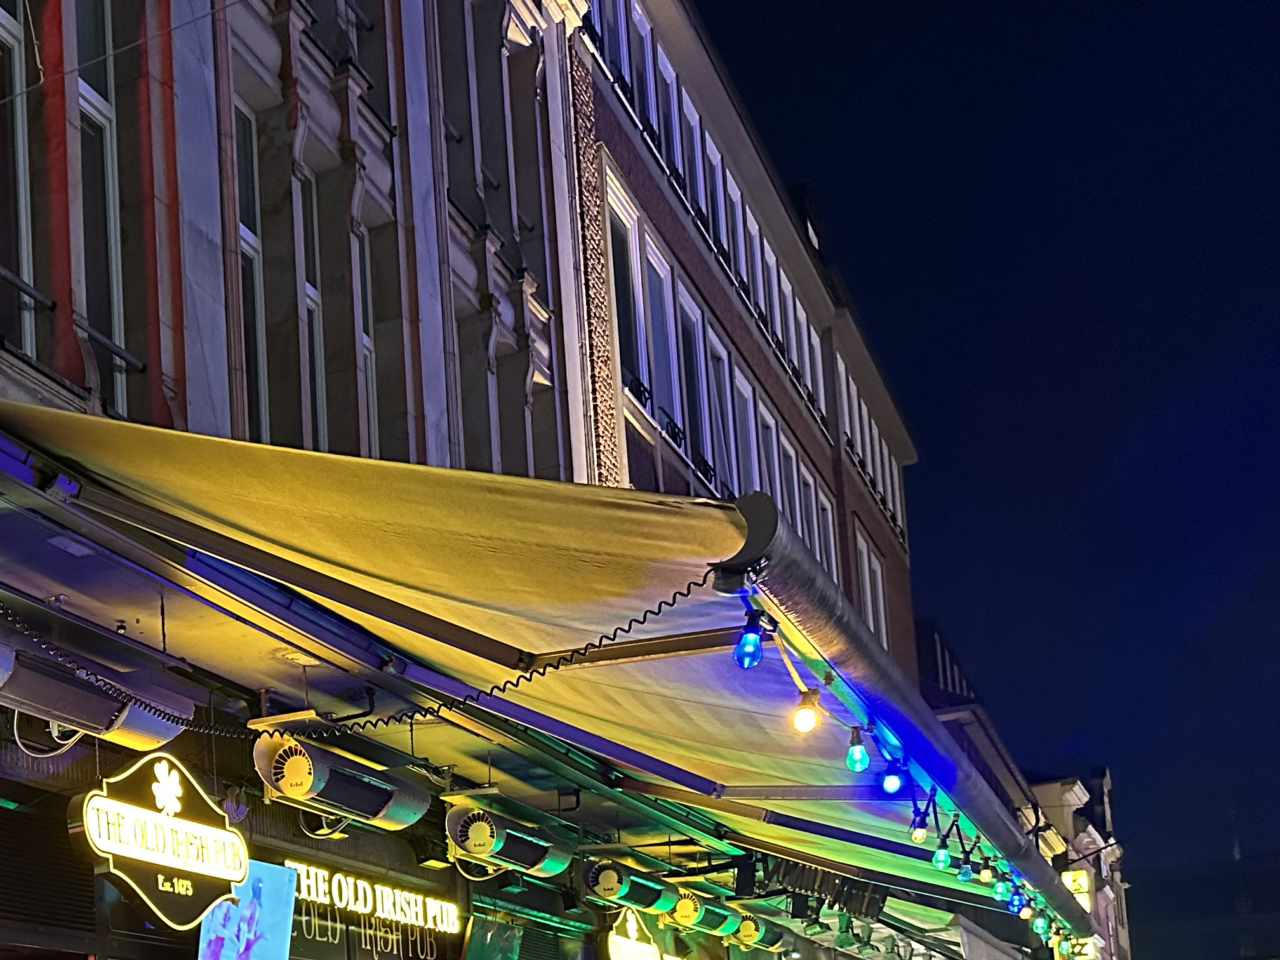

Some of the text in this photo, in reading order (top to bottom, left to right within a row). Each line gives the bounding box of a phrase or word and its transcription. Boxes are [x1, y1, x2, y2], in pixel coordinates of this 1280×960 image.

[91, 806, 243, 872] THE OLD IRISH PUB
[331, 872, 374, 915] OLD
[375, 883, 424, 930] IRISH
[424, 895, 460, 936] PUB
